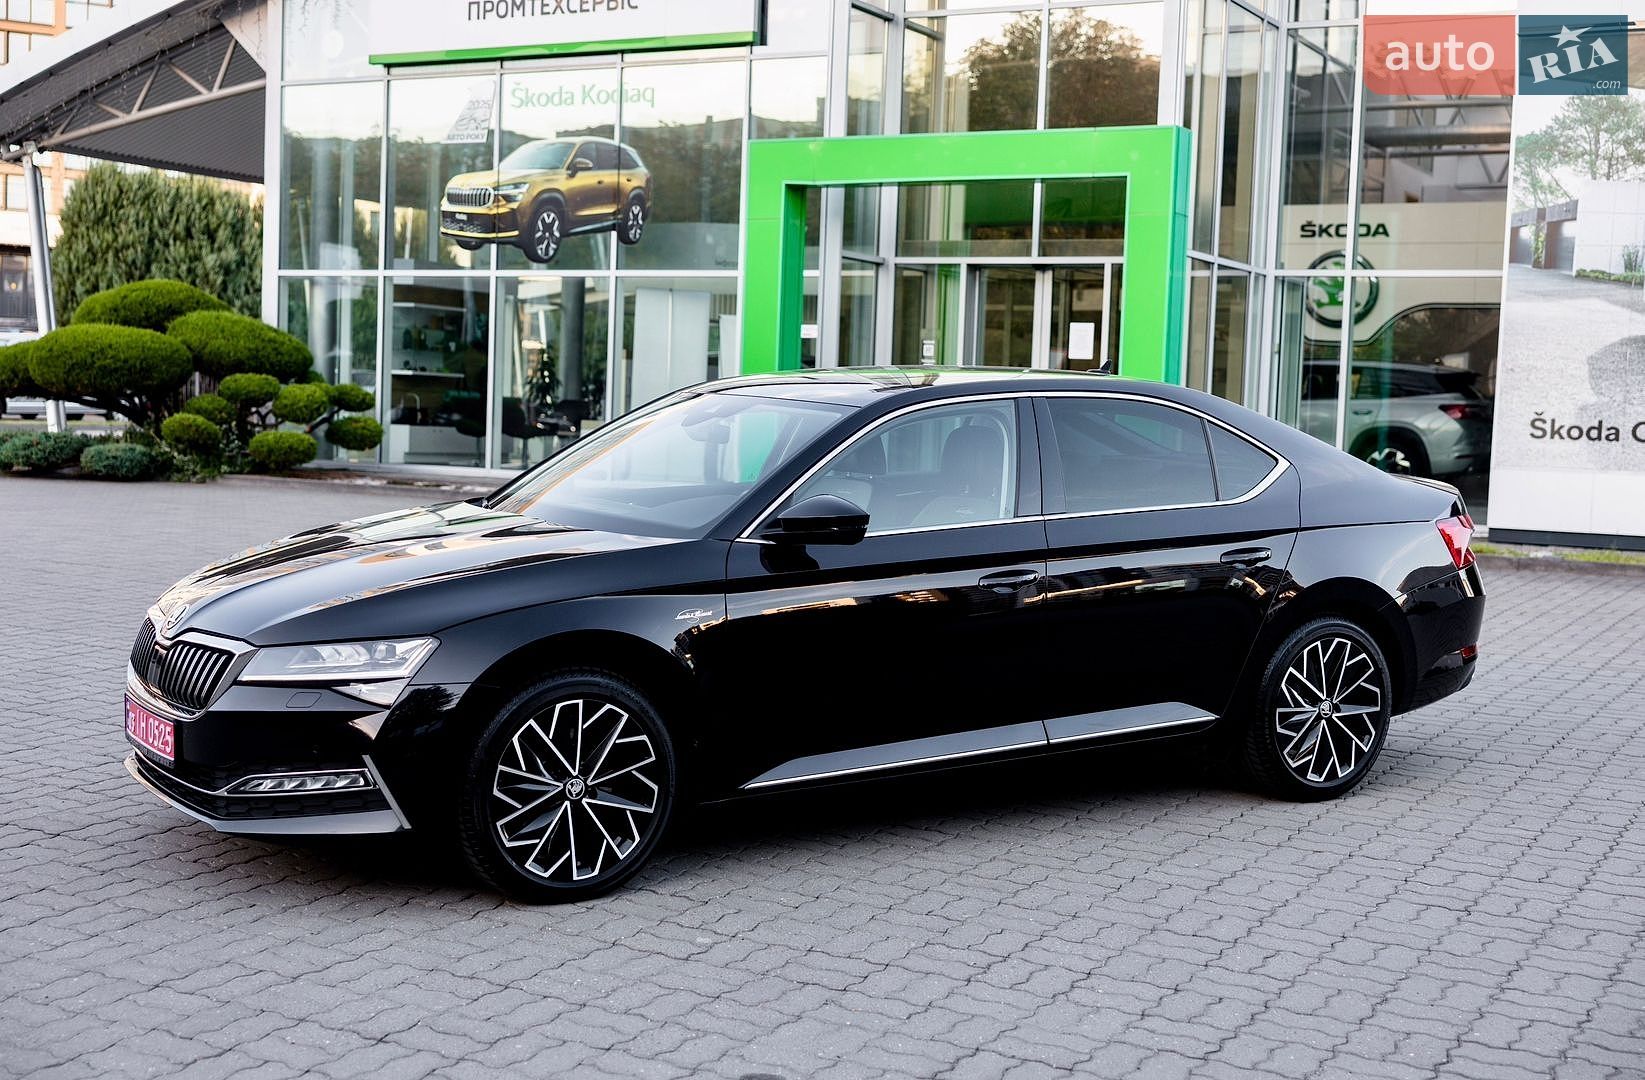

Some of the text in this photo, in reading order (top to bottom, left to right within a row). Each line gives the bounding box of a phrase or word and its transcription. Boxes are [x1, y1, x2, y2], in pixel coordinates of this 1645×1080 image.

[510, 82, 655, 109] Škoda Kodiaq
[1300, 220, 1390, 238] ŠKODA
[1529, 411, 1621, 442] Škoda
[148, 717, 172, 753] 0525
